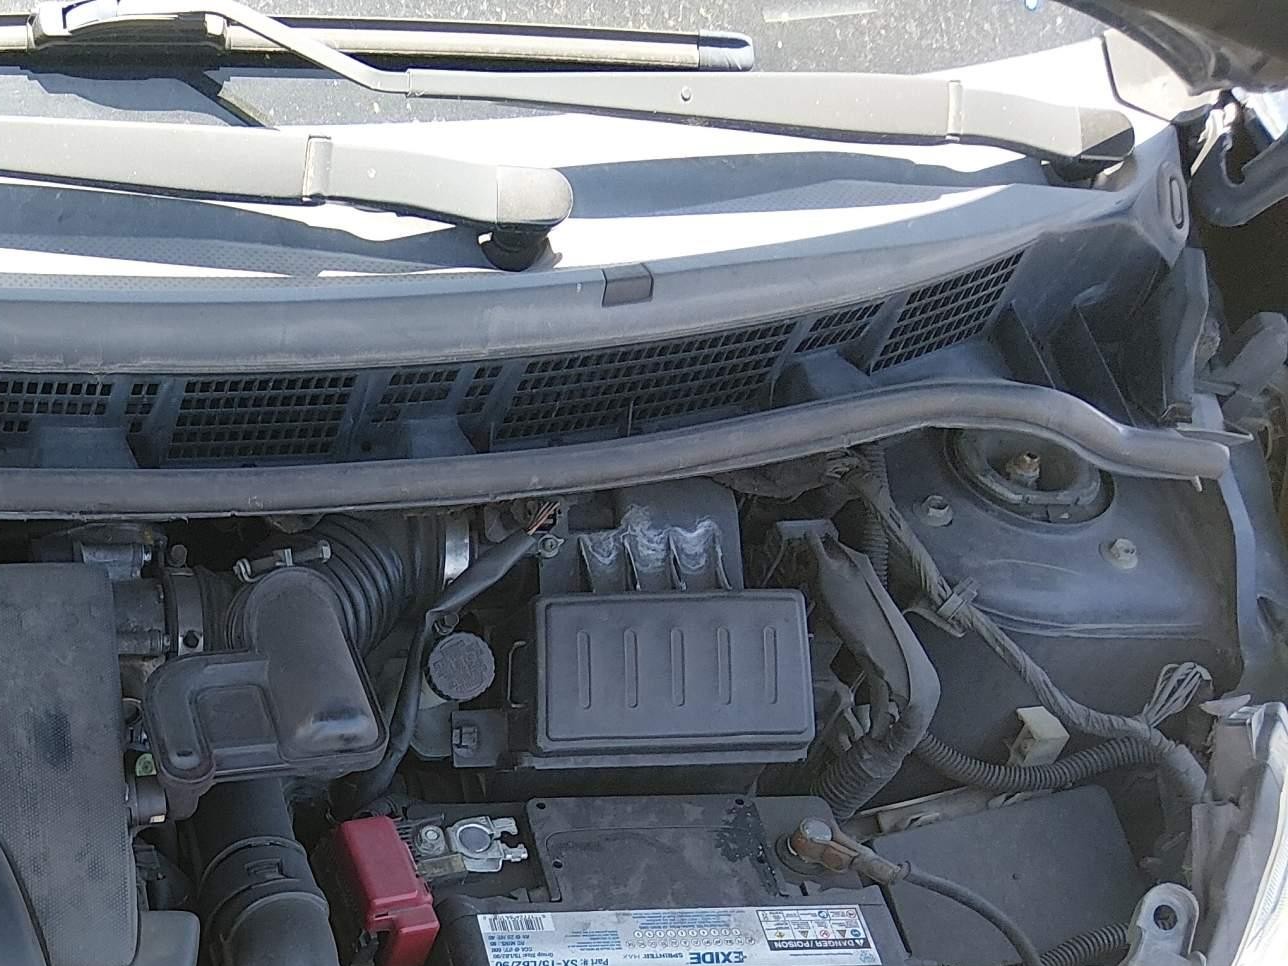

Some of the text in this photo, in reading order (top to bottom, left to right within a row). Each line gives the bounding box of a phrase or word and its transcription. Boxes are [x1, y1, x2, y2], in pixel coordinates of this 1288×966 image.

[774, 940, 809, 948] POISON
[815, 939, 854, 948] DANGER
[689, 950, 746, 964] EXIDE
[591, 958, 609, 966] Part
